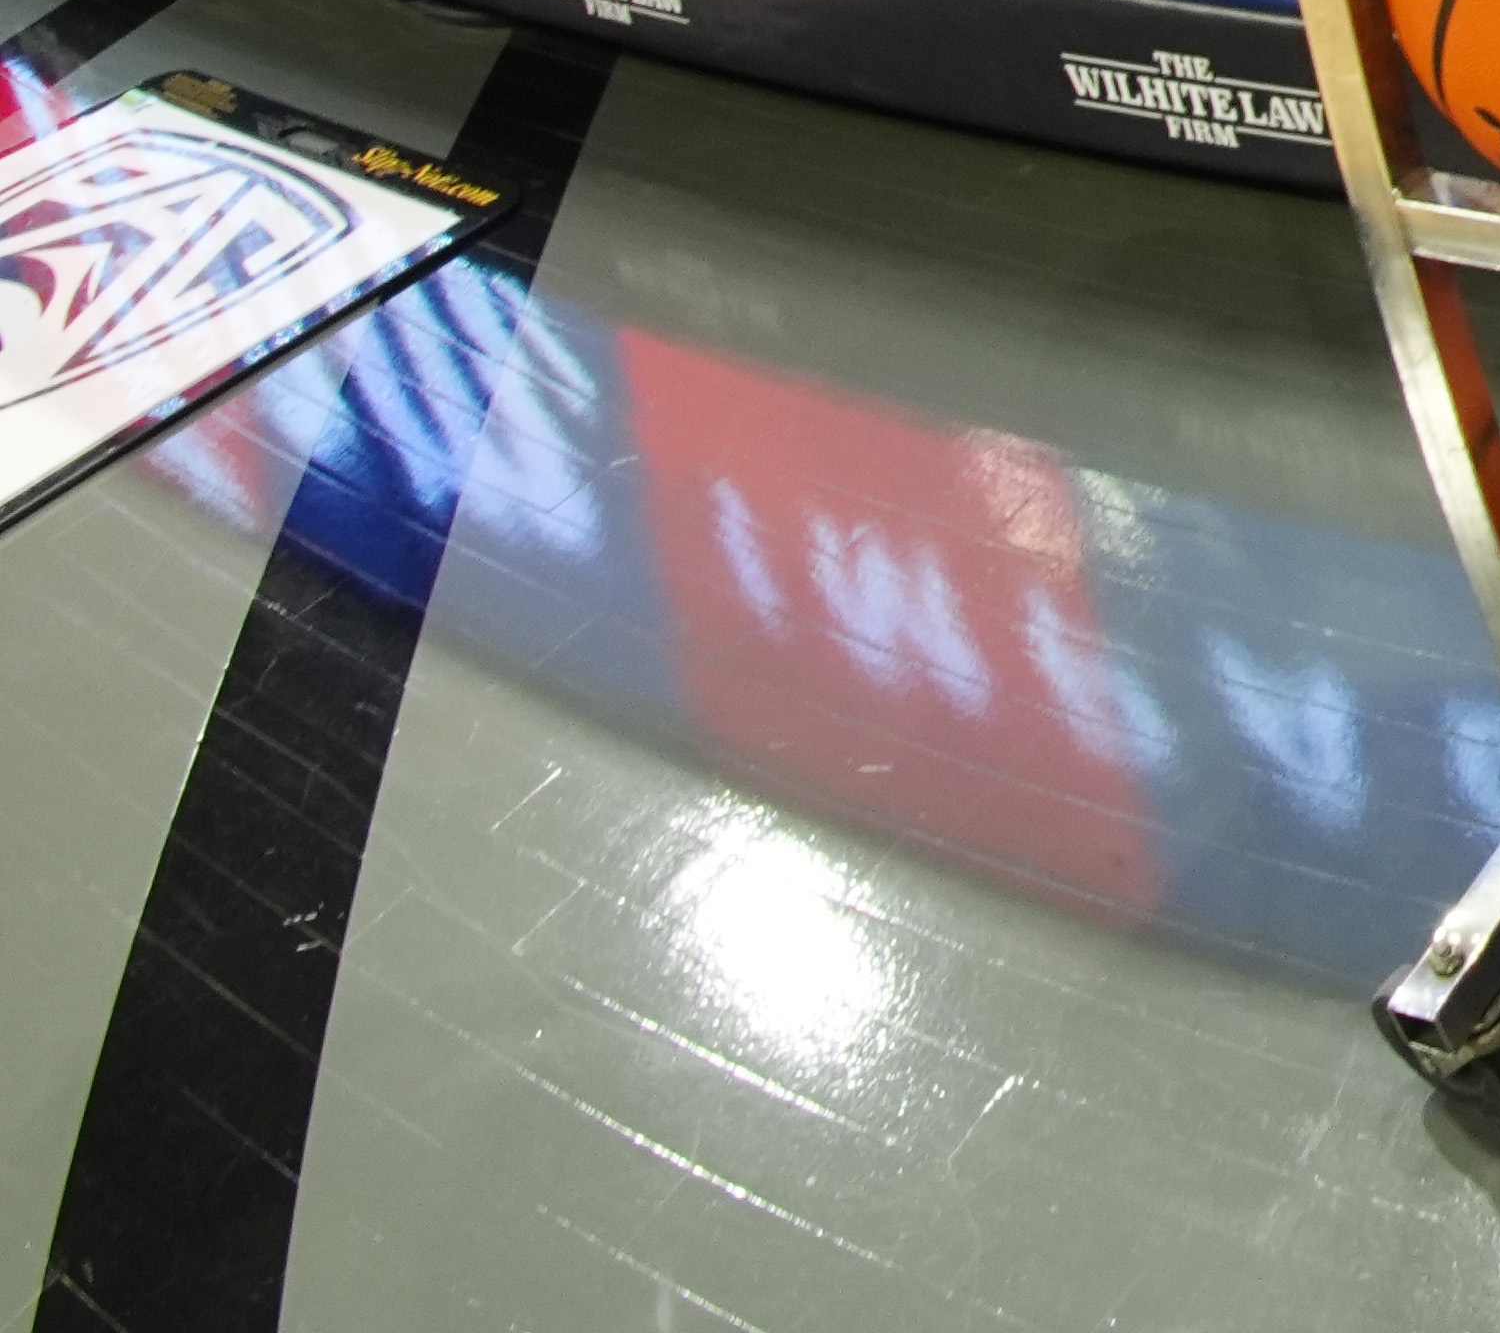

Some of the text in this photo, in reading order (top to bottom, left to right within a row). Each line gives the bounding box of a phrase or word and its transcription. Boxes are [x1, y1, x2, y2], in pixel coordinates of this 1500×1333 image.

[1152, 50, 1214, 83] THE
[1064, 63, 1325, 134] WILHITE LAW
[1164, 115, 1240, 149] FIRM
